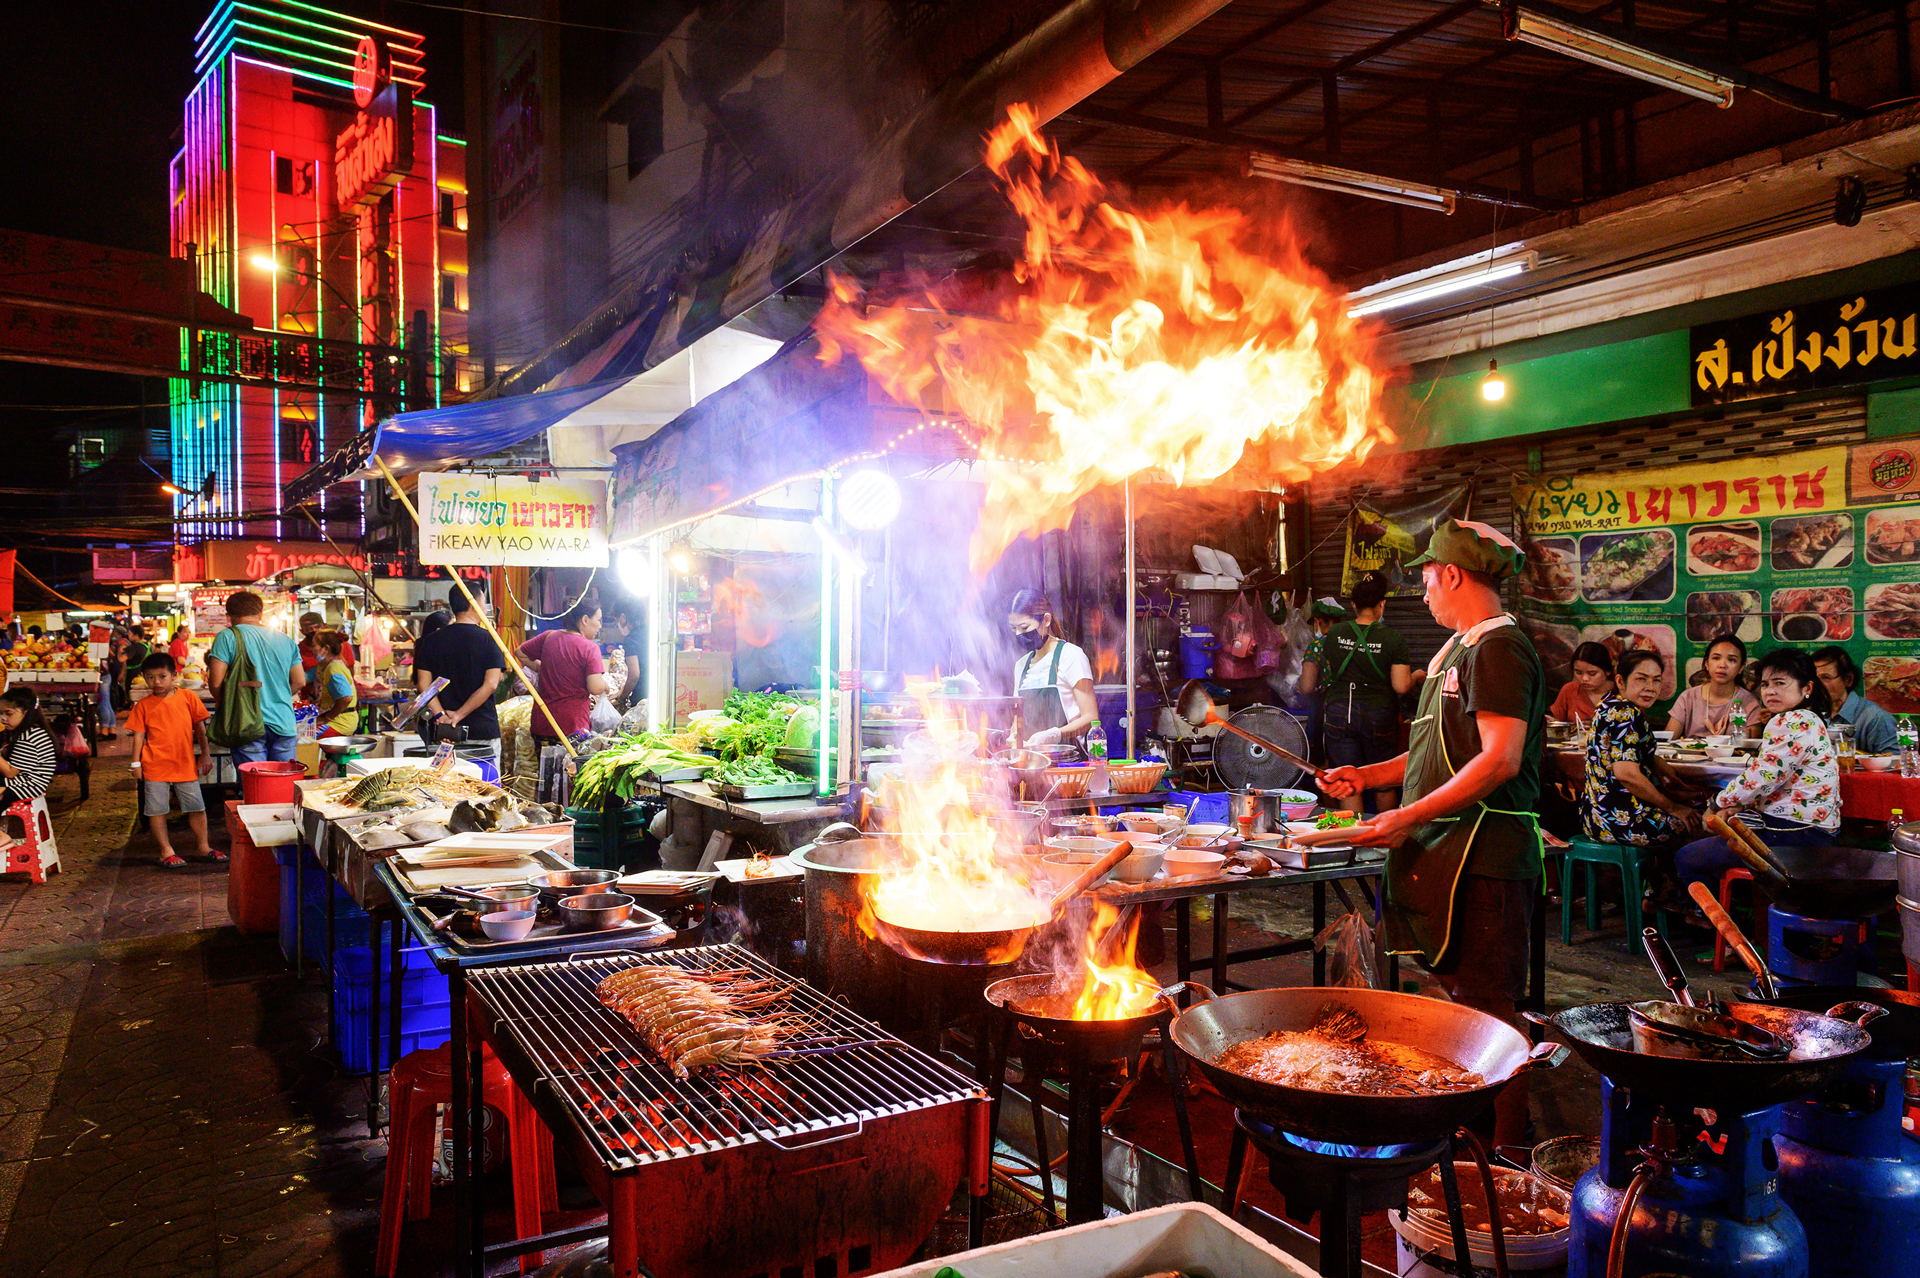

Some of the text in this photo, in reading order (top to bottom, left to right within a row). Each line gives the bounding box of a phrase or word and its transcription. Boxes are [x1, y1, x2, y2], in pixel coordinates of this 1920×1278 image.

[426, 484, 507, 527] ไฟเขียว
[1626, 465, 1829, 525] เยาวราช
[1551, 521, 1571, 533] YAO
[1573, 517, 1622, 529] WA-RAT
[429, 534, 597, 552] FIKEAW YAO WA-RA
